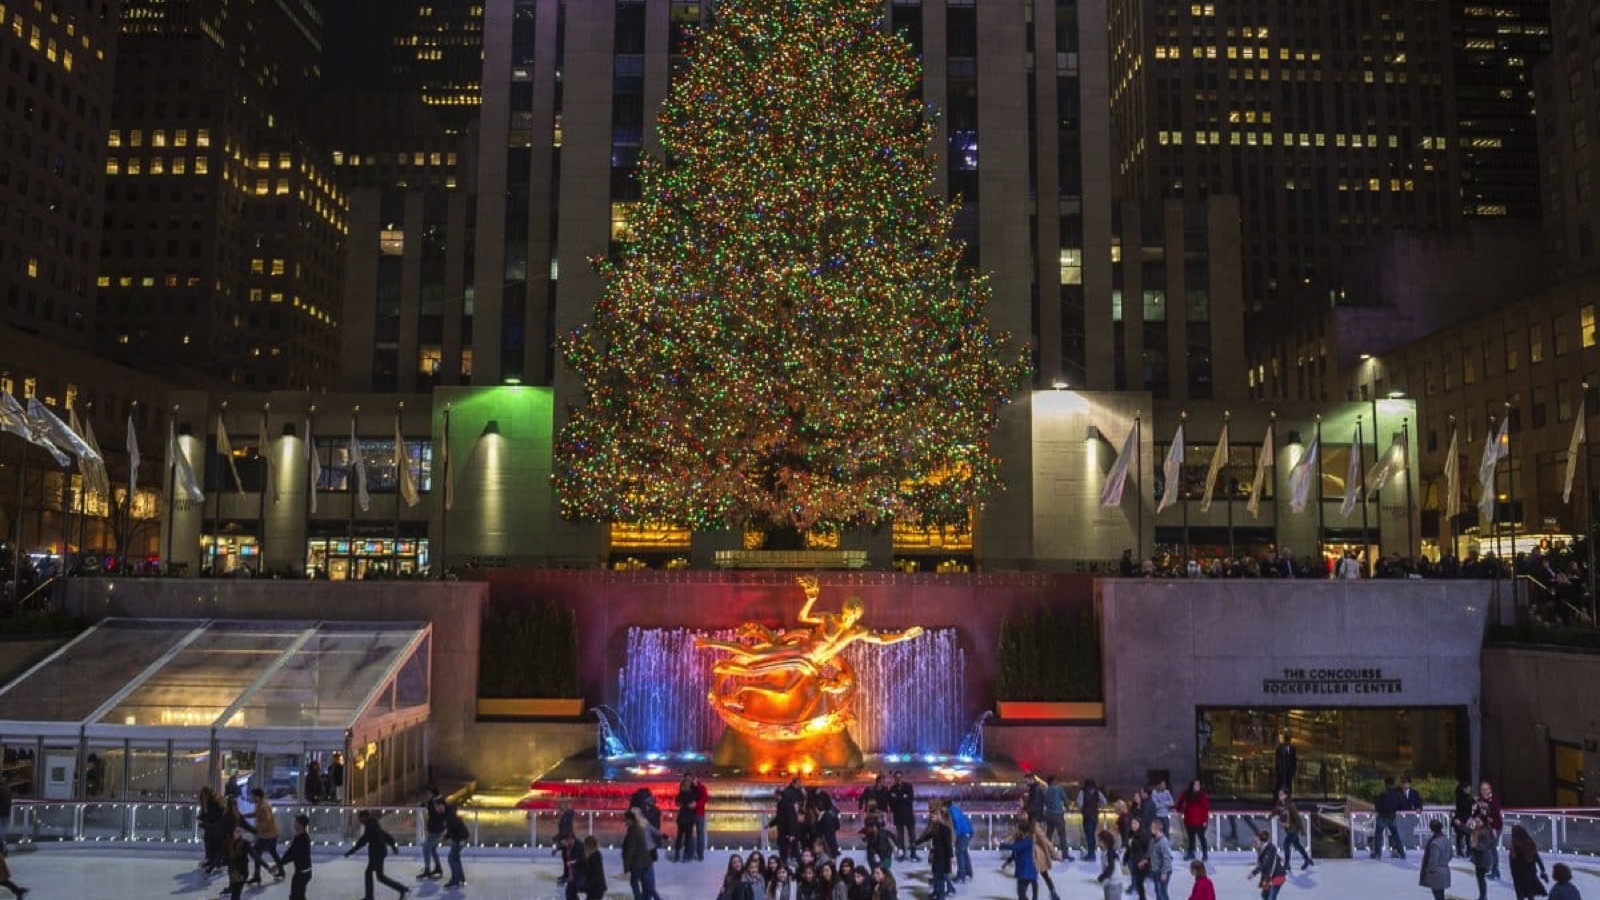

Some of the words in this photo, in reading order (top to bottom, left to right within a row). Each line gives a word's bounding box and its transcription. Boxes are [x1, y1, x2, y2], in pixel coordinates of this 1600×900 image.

[1283, 669, 1305, 679] THE
[1309, 669, 1382, 679] CONCOURSE
[1262, 683, 1349, 694] ROCKEFELLER
[1354, 683, 1403, 694] CENTER
